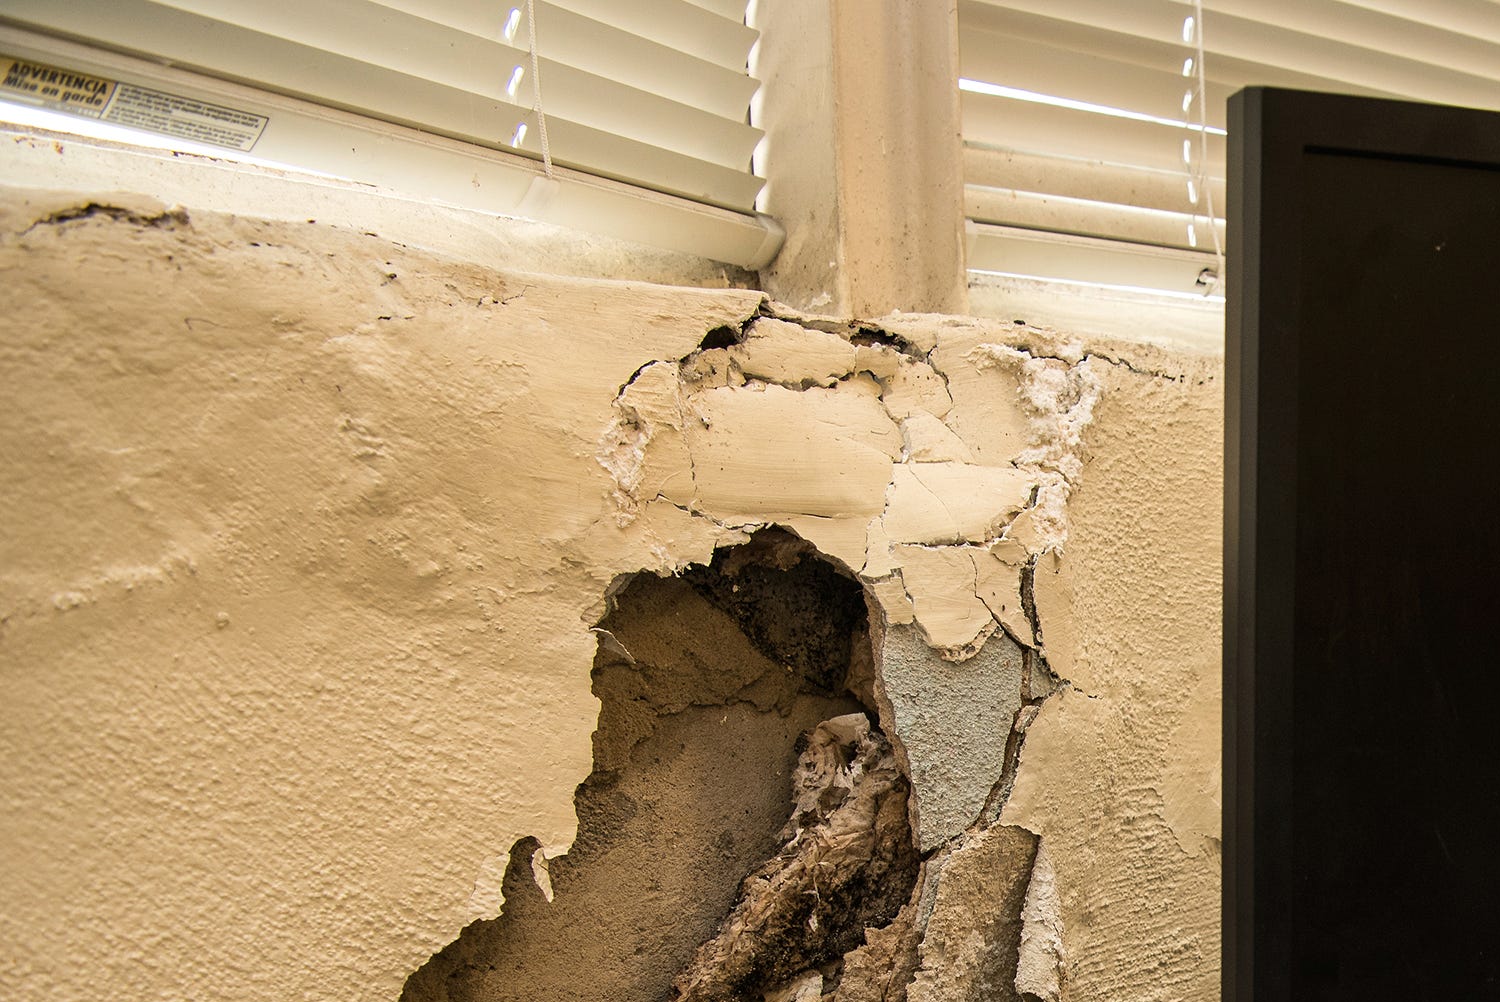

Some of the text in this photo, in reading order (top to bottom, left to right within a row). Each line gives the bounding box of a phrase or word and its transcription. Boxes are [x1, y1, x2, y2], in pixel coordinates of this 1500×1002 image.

[3, 76, 102, 105] Mise en garde
[9, 62, 107, 95] ADVERTENCIA
